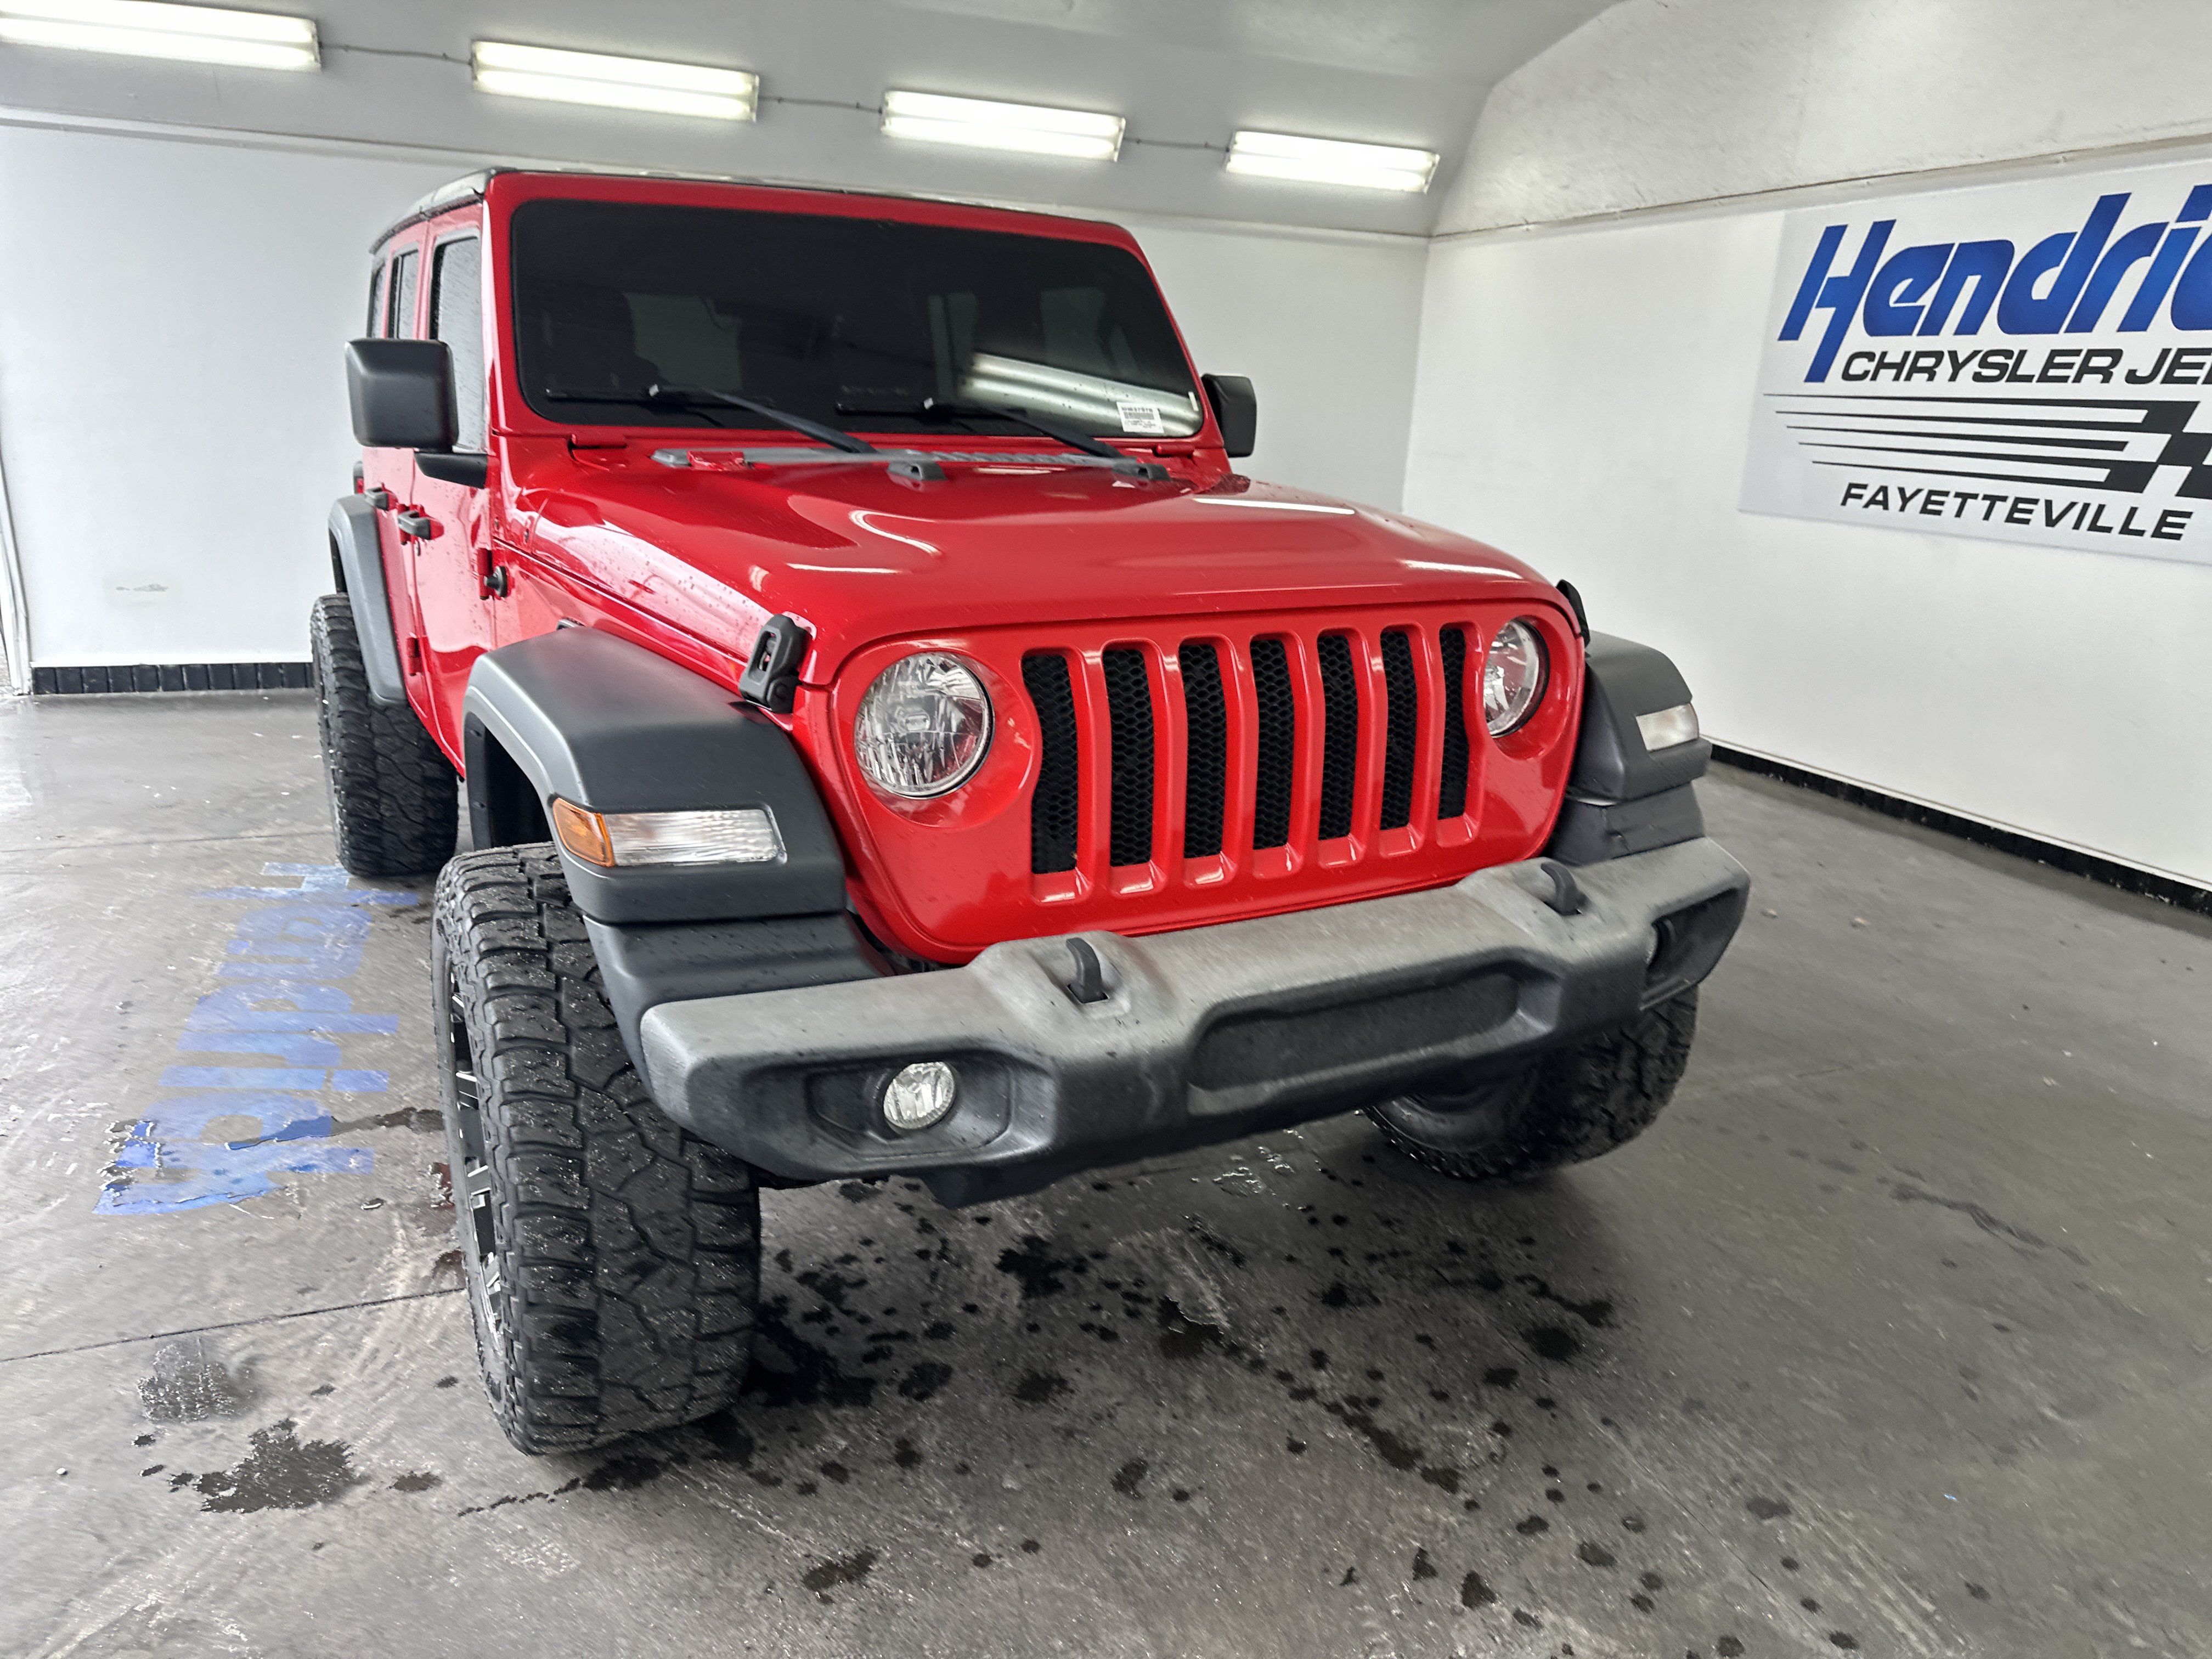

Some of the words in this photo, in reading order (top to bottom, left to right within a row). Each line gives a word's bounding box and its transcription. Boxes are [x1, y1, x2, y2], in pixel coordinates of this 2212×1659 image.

[1841, 348, 2124, 383] CHRYSLER
[2125, 348, 2212, 384] JE
[1840, 482, 2193, 540] FAYETTEVILLE
